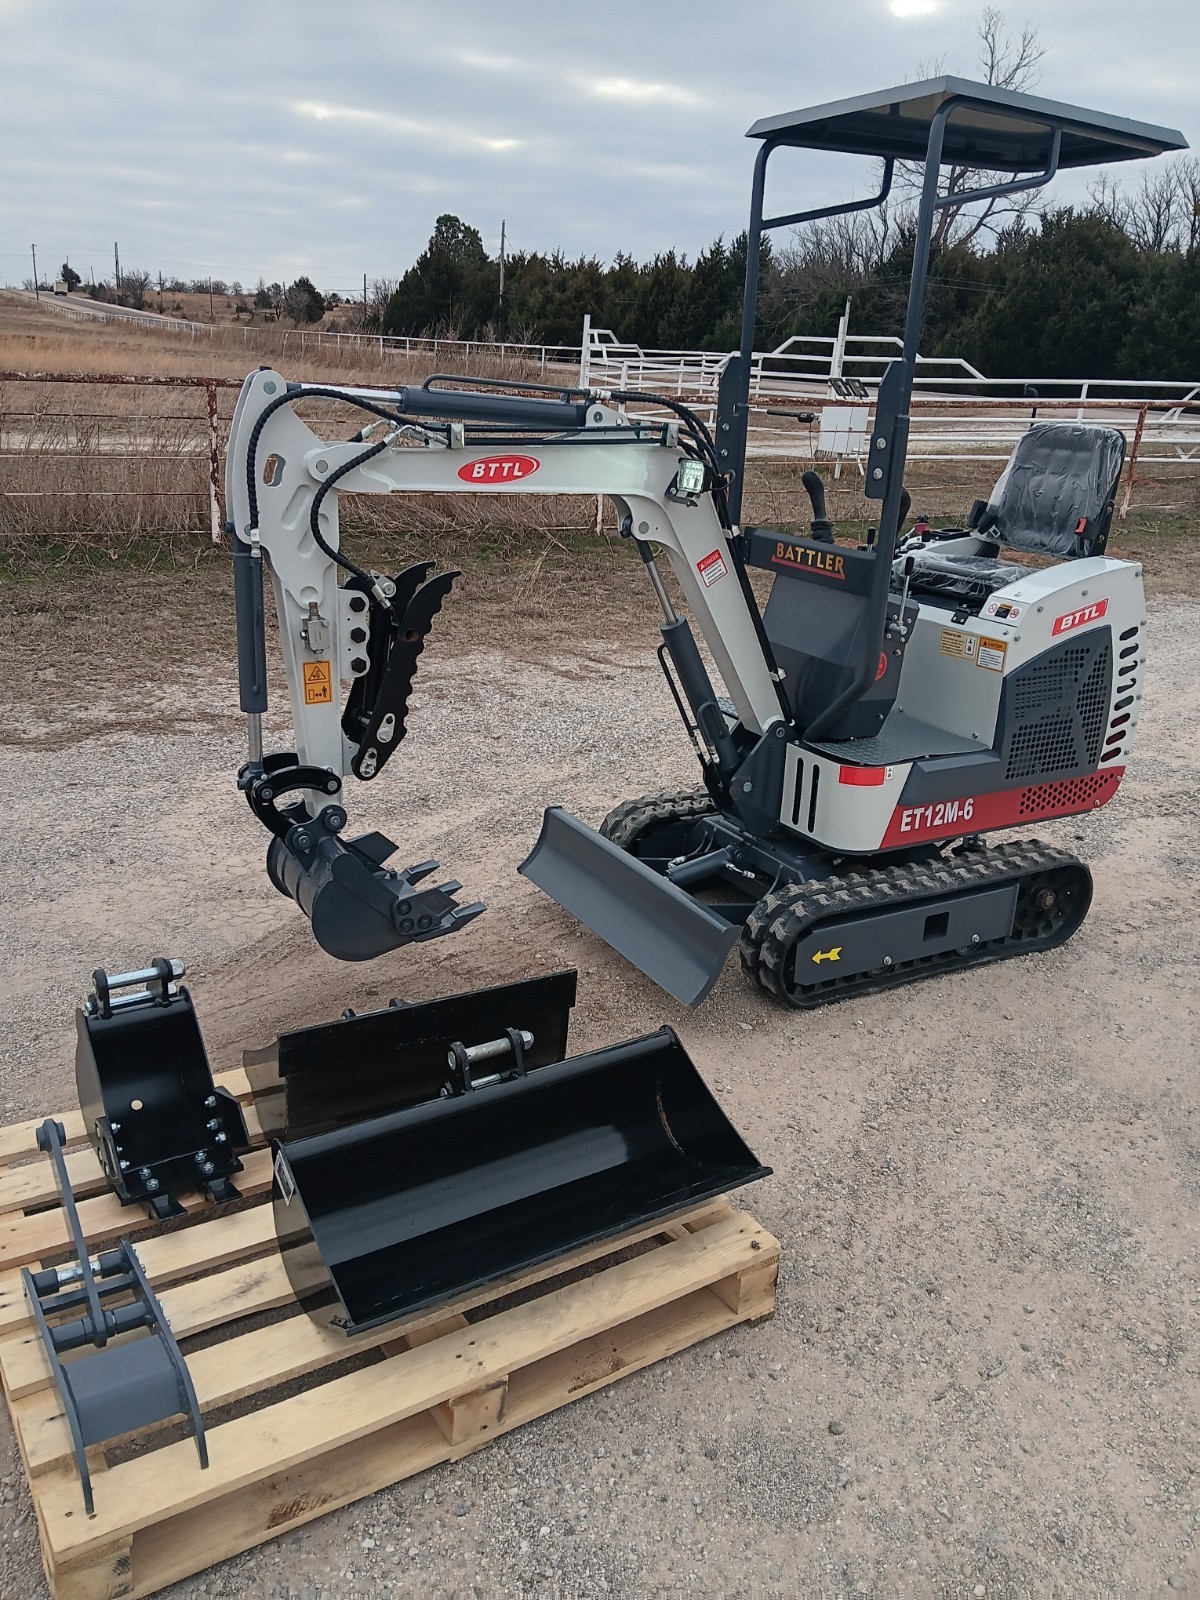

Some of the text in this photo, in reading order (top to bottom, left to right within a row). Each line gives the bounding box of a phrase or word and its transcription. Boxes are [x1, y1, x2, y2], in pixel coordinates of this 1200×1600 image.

[472, 463, 523, 478] BTTL
[776, 542, 845, 577] BATTLER
[1060, 605, 1100, 630] BTTL
[900, 798, 974, 832] ET12M-6
